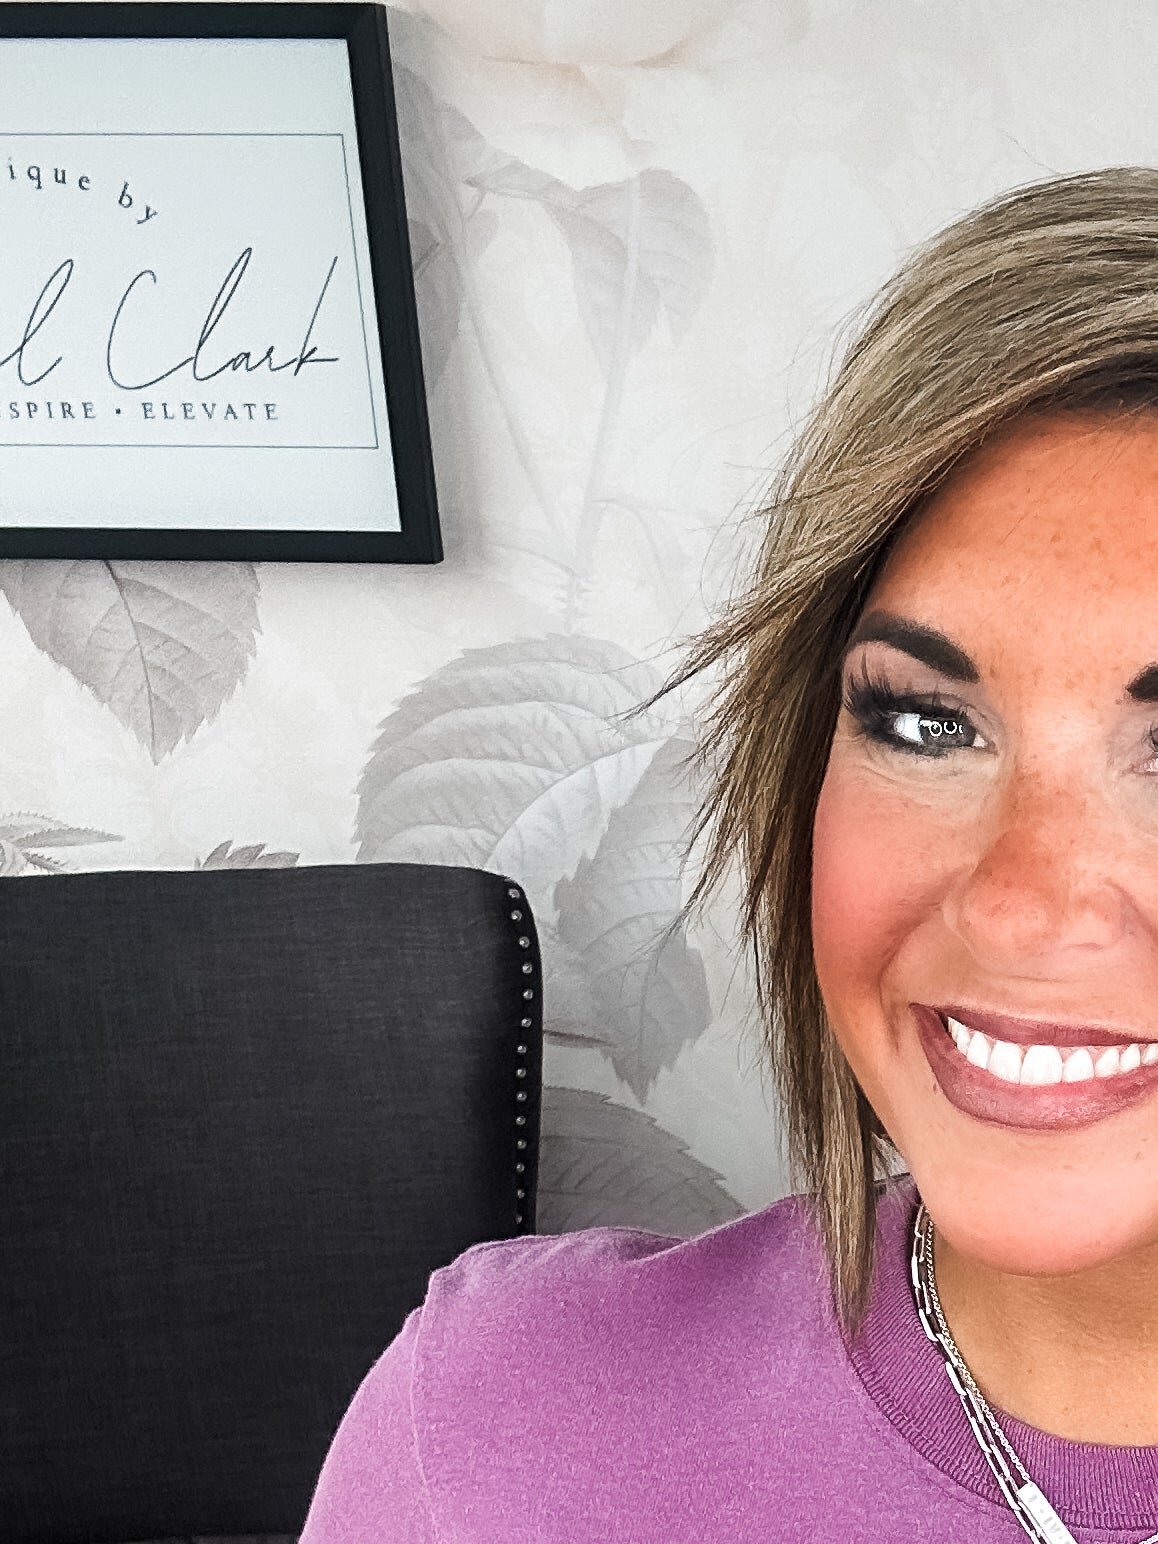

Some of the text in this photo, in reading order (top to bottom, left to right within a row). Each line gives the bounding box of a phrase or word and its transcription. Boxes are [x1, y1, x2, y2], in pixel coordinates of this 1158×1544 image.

[117, 180, 159, 225] by
[106, 247, 340, 391] Clark
[0, 401, 279, 421] SPIRE ELEVATE
